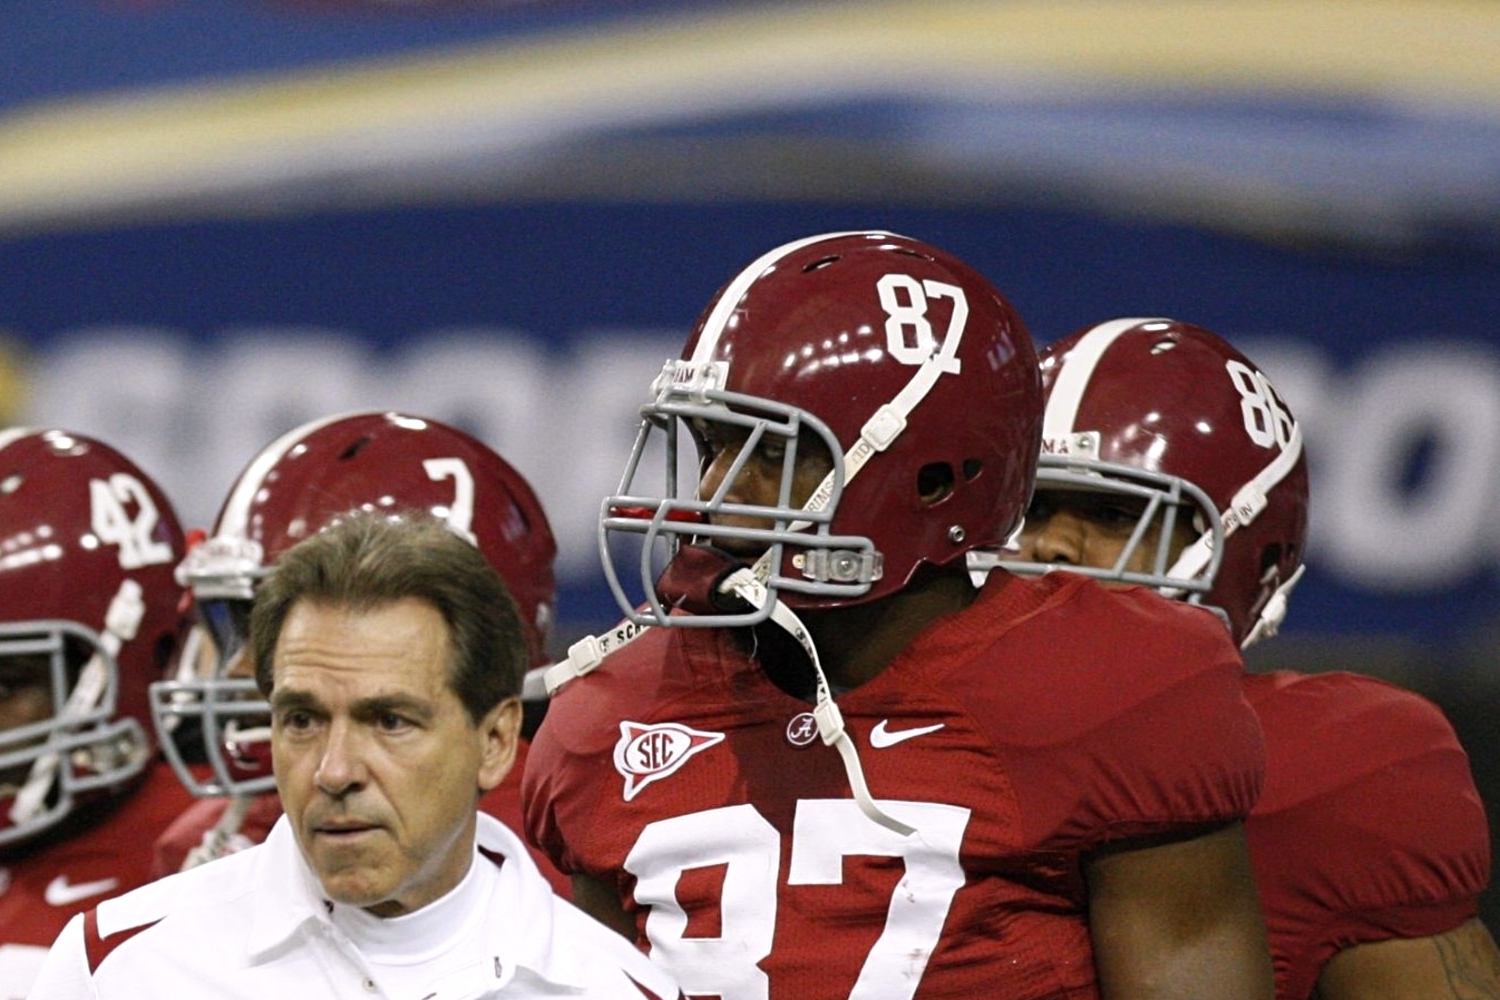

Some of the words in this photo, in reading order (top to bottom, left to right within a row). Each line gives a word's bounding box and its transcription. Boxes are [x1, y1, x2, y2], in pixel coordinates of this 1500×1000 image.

[876, 273, 969, 375] 87
[88, 472, 174, 570] 42
[422, 457, 488, 549] 7
[637, 732, 674, 770] SEC
